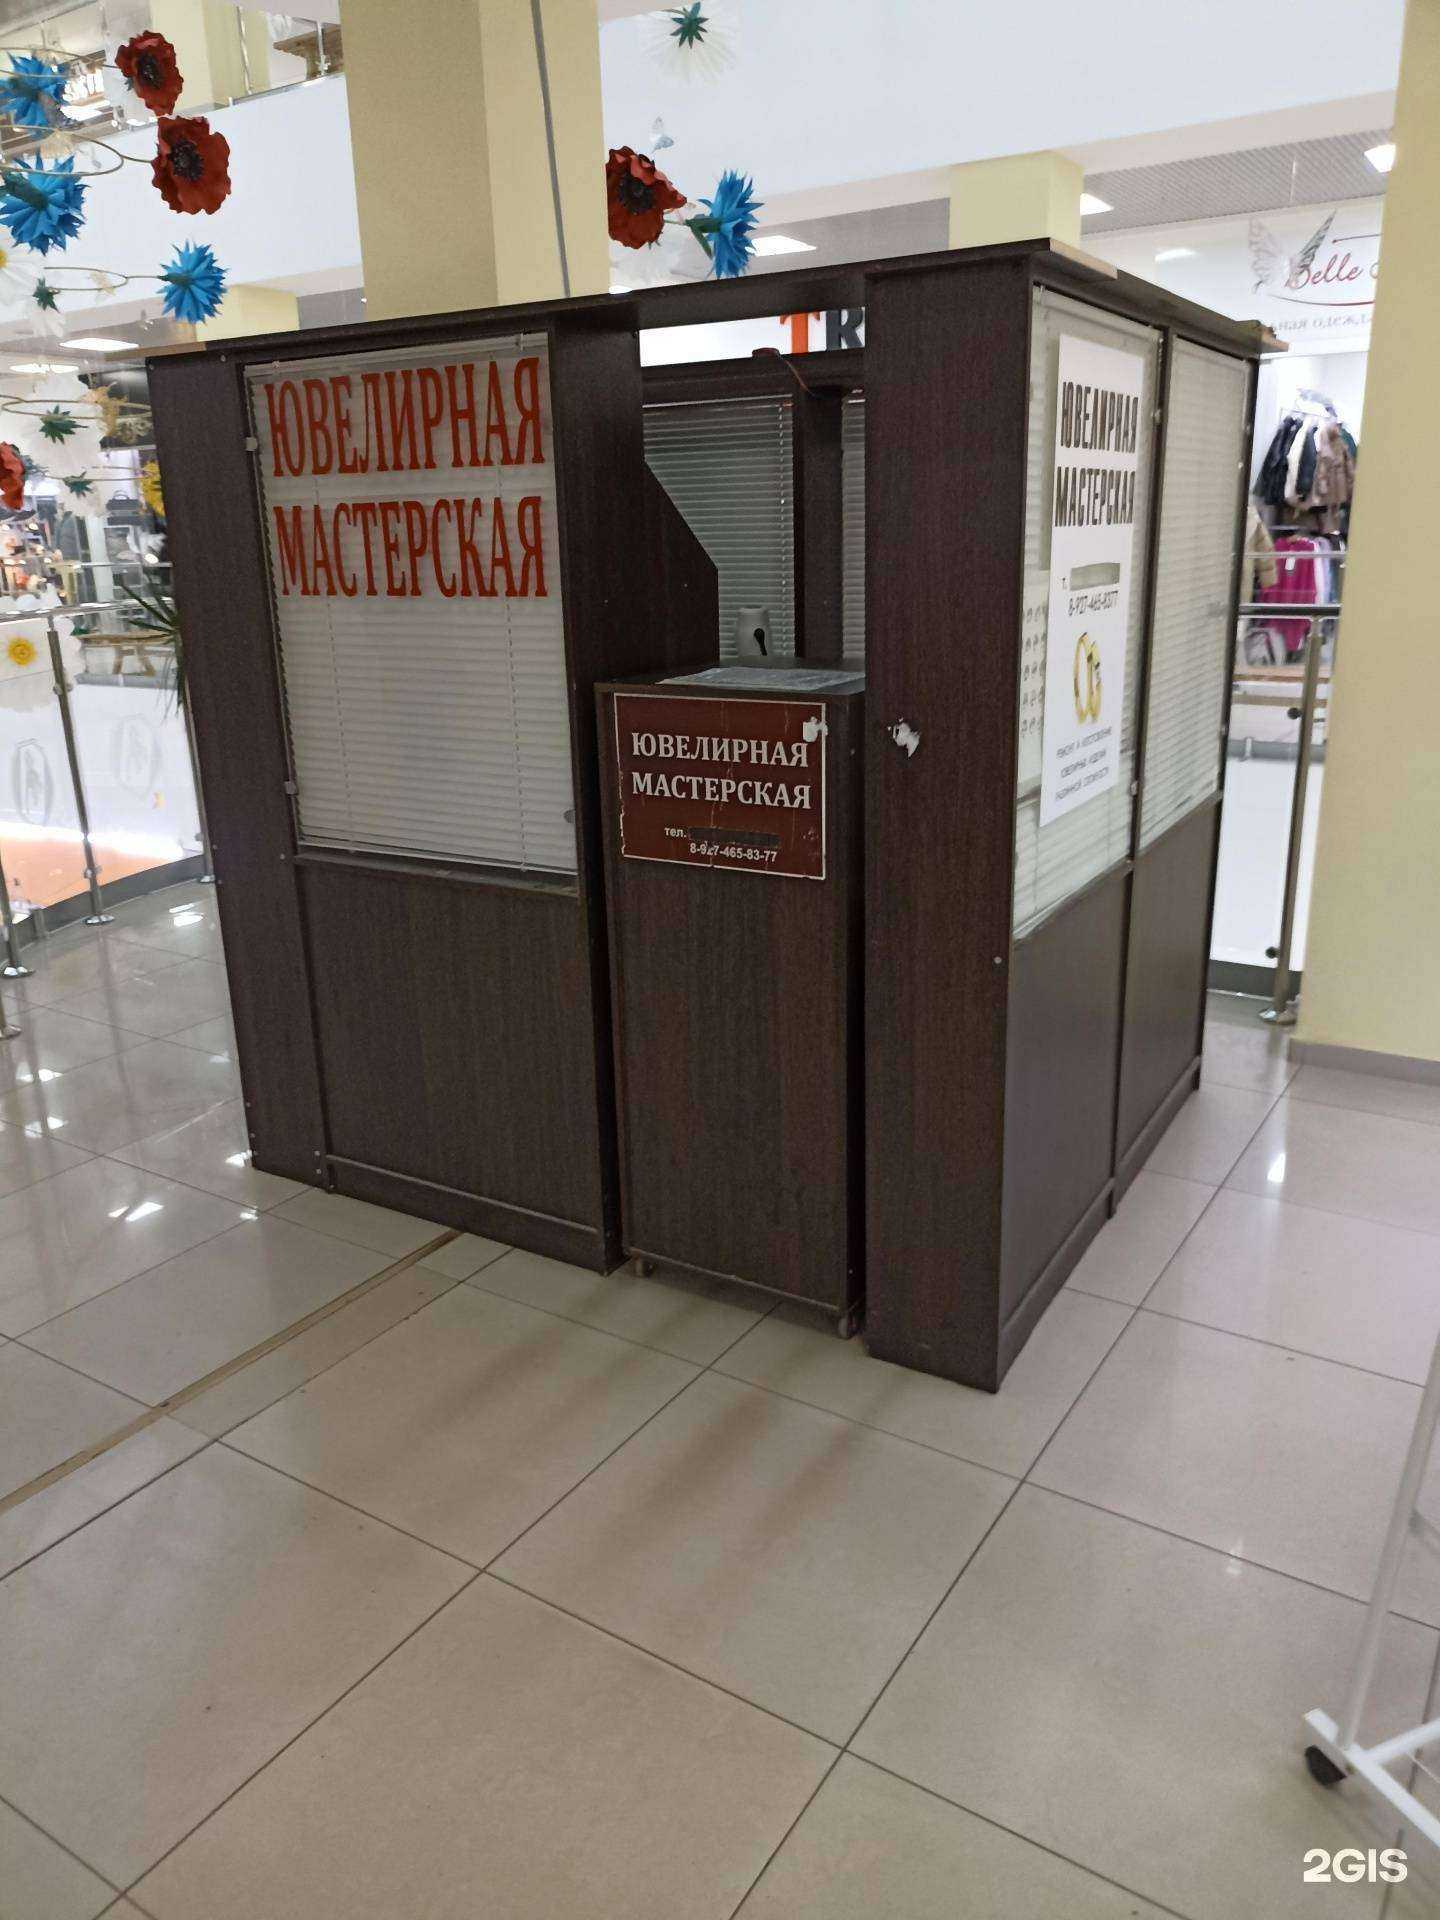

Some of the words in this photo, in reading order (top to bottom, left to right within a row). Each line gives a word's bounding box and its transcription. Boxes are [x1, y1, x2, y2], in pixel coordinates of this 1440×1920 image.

[1285, 252, 1362, 289] Belle
[264, 357, 545, 477] ЮВЕЛИРНАЯ
[1061, 381, 1139, 454] ЮВЕЛИРНАЯ
[1055, 466, 1136, 527] МАСТЕРСКАЯ
[273, 496, 548, 597] МАСТЕРСКАЯ
[631, 732, 809, 768] ЮВЕЛИРНАЯ
[631, 771, 811, 810] МАСТЕРСКАЯ
[664, 827, 687, 838] тел.
[689, 842, 778, 863] 8-927-465-83-77
